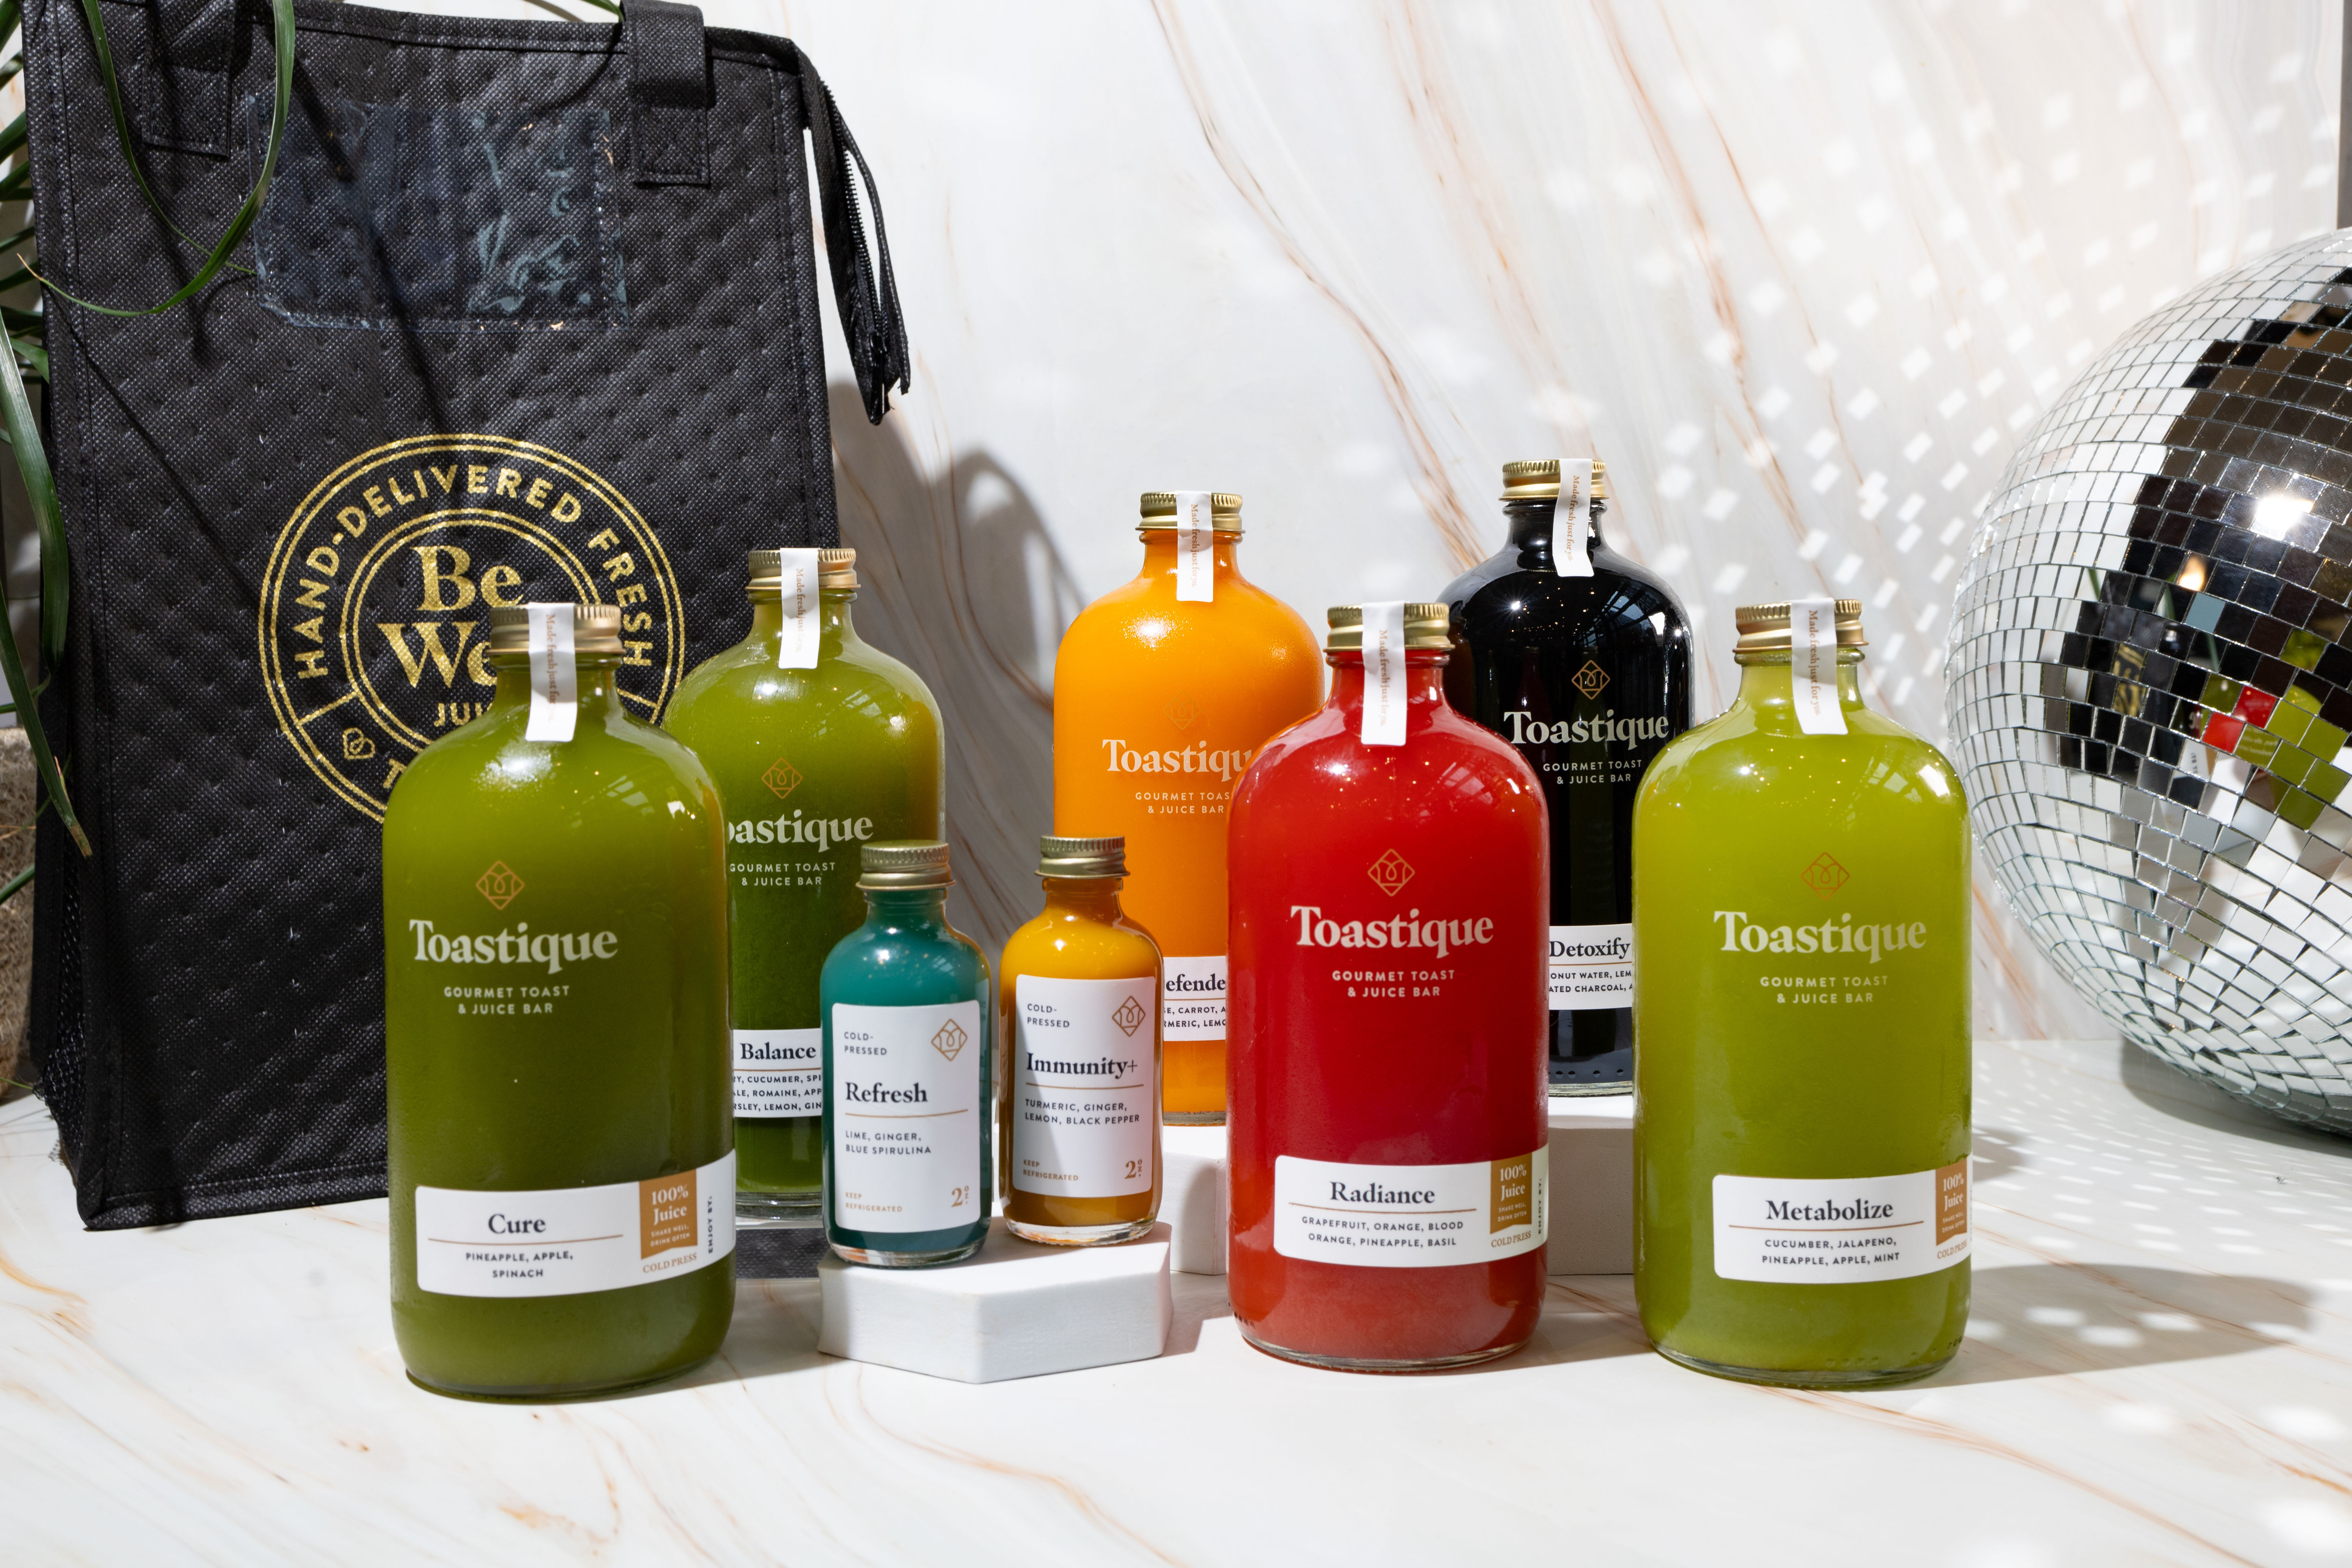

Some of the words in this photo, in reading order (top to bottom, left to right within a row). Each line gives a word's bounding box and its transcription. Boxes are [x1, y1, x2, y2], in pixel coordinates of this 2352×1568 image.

[1572, 475, 1580, 499] Made
[1191, 504, 1199, 527] Made
[1568, 500, 1578, 520] fresh
[1192, 528, 1200, 549] fresh
[1566, 538, 1574, 551] for
[1190, 549, 1199, 566] just
[294, 465, 582, 680] HAND-DELIVERED
[587, 527, 652, 668] FRESH
[409, 545, 525, 611] Be
[796, 568, 804, 593] Made
[797, 594, 806, 615] fresh
[546, 614, 556, 642] Made
[796, 615, 805, 631] just
[1809, 610, 1819, 638] Made
[1379, 629, 1388, 658] Made
[1810, 640, 1820, 664] fresh
[377, 621, 498, 688] We
[547, 644, 557, 670] fresh
[546, 670, 557, 689] just
[1380, 659, 1390, 683] fresh
[1808, 665, 1819, 684] just
[549, 690, 560, 705] for
[1380, 685, 1390, 703] just
[1810, 686, 1821, 700] for
[1504, 709, 1669, 750] Toastique
[1543, 762, 1603, 771] GOURMET
[1608, 760, 1642, 769] TOAST
[1557, 776, 1563, 785] &
[1569, 775, 1604, 784] JUICE
[1611, 774, 1631, 782] BAR
[1135, 792, 1194, 800] GOURMET
[730, 863, 789, 872] GOURMET
[796, 862, 835, 871] TOAST
[741, 878, 748, 886] &
[754, 877, 790, 886] JUICE
[798, 876, 822, 885] BAR
[1290, 905, 1494, 959] Toastique
[1713, 911, 1927, 964] Toastique
[409, 919, 618, 974] Toastique
[1550, 937, 1630, 959] Detoxify
[1332, 970, 1404, 981] GOURMET
[1411, 969, 1455, 980] TOAST
[1760, 976, 1836, 988] GOURMET
[1843, 976, 1888, 987] TOAST
[444, 987, 513, 998] GOURMET
[520, 986, 569, 997] TOAST
[1348, 987, 1356, 997] &
[1363, 987, 1406, 998] JUICE
[1413, 987, 1440, 997] BAR
[1575, 984, 1626, 992] CHARCOAL,
[1777, 994, 1786, 1004] &
[1793, 994, 1837, 1004] JUICE
[1846, 993, 1873, 1003] BAR
[458, 1004, 466, 1014] &
[473, 1004, 515, 1015] JUICE
[524, 1003, 553, 1014] BAR
[1028, 1003, 1057, 1013] COLD-
[1027, 1017, 1070, 1028] PRESSED
[844, 1032, 874, 1041] COLD-
[740, 1041, 816, 1060] Balance
[844, 1045, 887, 1056] PRESSED
[1026, 1052, 1138, 1079] Immunity+
[845, 1082, 928, 1103] Refresh
[765, 1103, 801, 1111] LEMON,
[1025, 1098, 1080, 1113] TURMERIC,
[1084, 1102, 1127, 1112] GINGER,
[1025, 1112, 1062, 1126] LEMON,
[1067, 1117, 1101, 1125] BLACK
[1106, 1115, 1140, 1124] PEPPER
[845, 1130, 871, 1142] LIME,
[875, 1133, 921, 1142] GINGER,
[846, 1145, 868, 1154] BLUE
[873, 1146, 932, 1155] SPIRULINA
[1023, 1159, 1040, 1168] KEEP
[1125, 1160, 1137, 1179] 2
[1023, 1169, 1079, 1181] REFRIGERATED
[1500, 1163, 1527, 1182] 100%
[1943, 1171, 1964, 1192] 100%
[652, 1184, 689, 1205] 100%
[845, 1192, 862, 1200] KEEP
[951, 1187, 964, 1208] 2
[1329, 1181, 1435, 1204] Radiance
[1501, 1183, 1525, 1201] Juice
[845, 1203, 902, 1212] REFRIGERATED
[1765, 1198, 1893, 1221] Metabolize
[1944, 1193, 1963, 1212] Juice
[488, 1213, 546, 1234] Cure
[654, 1206, 687, 1226] Juice
[1302, 1216, 1370, 1232] GRAPEFRUIT,
[1374, 1223, 1424, 1232] ORANGE,
[1429, 1221, 1463, 1230] BLOOD
[650, 1238, 670, 1247] DRINK
[672, 1232, 690, 1242] OFTEN
[651, 1228, 670, 1237] SHAKE
[1309, 1233, 1355, 1246] ORANGE,
[1360, 1238, 1423, 1248] PINEAPPLE,
[1427, 1238, 1457, 1247] BASIL
[1491, 1237, 1512, 1247] COLD
[1513, 1230, 1532, 1243] PRESS
[1765, 1239, 1833, 1249] CUCUMBER,
[1837, 1237, 1897, 1248] JALAPENO,
[466, 1252, 529, 1263] PINEAPPLE,
[533, 1251, 573, 1260] APPLE,
[1762, 1255, 1828, 1266] PINEAPPLE,
[1833, 1256, 1870, 1265] APPLE,
[1874, 1252, 1900, 1262] MINT
[1937, 1248, 1954, 1259] COLD
[643, 1260, 670, 1273] COLD
[672, 1252, 697, 1267] PRESS
[492, 1269, 544, 1278] SPINACH
